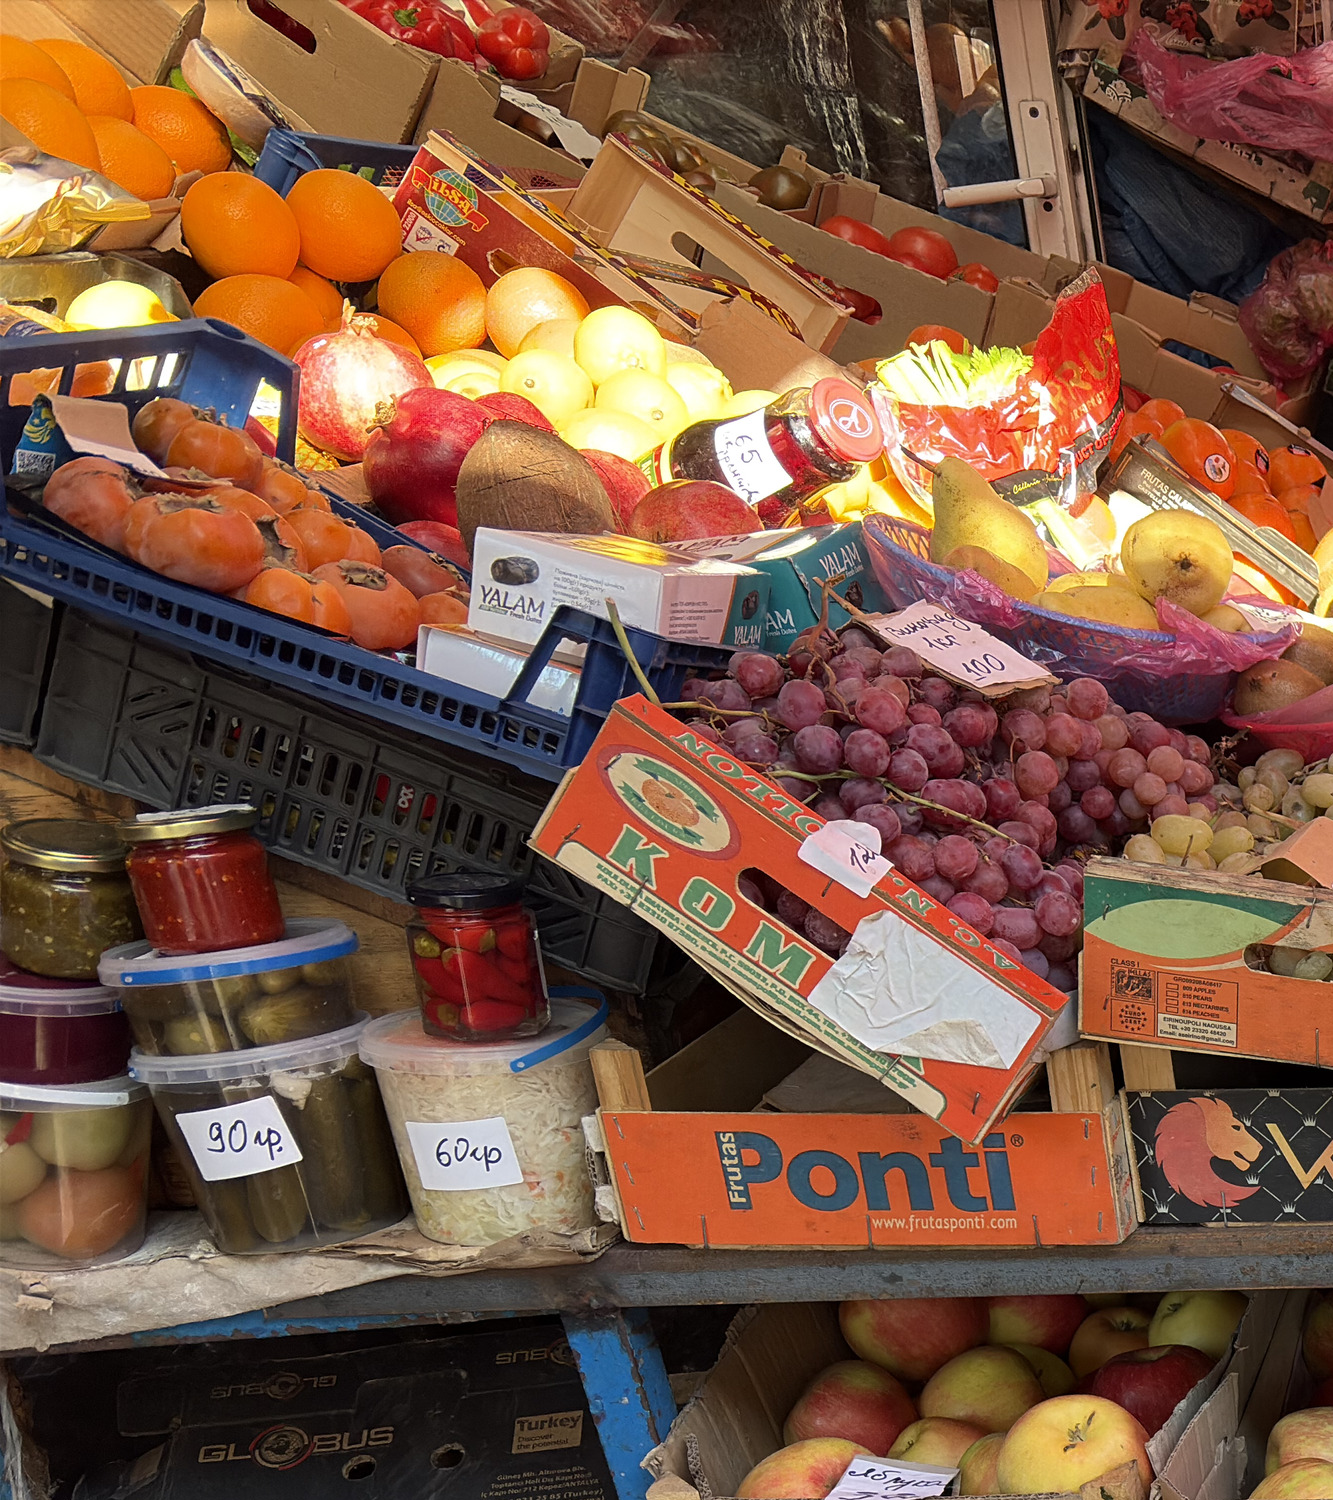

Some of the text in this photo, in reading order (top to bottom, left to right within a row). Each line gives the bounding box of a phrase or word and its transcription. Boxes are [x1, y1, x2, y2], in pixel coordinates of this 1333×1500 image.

[819, 542, 863, 578] YALAM
[480, 585, 546, 619] YALAM
[734, 625, 762, 646] YALAM
[961, 652, 1006, 679] 100
[1110, 957, 1136, 968] CLASS
[1192, 994, 1213, 1003] PEARS
[1193, 987, 1217, 995] APPLES
[1192, 1010, 1220, 1019] PEACHES
[1163, 1016, 1232, 1031] EIRINOUPOLI NAOUSSA
[719, 1128, 1017, 1213] Frutas Ponti
[871, 1214, 1018, 1232] www.frutasponti.com
[516, 1414, 582, 1433] Turkey
[516, 1438, 569, 1450] the potential
[517, 1433, 555, 1443] Discover
[198, 1424, 395, 1471] GLOBUS
[563, 1488, 604, 1500] (Turkey)
